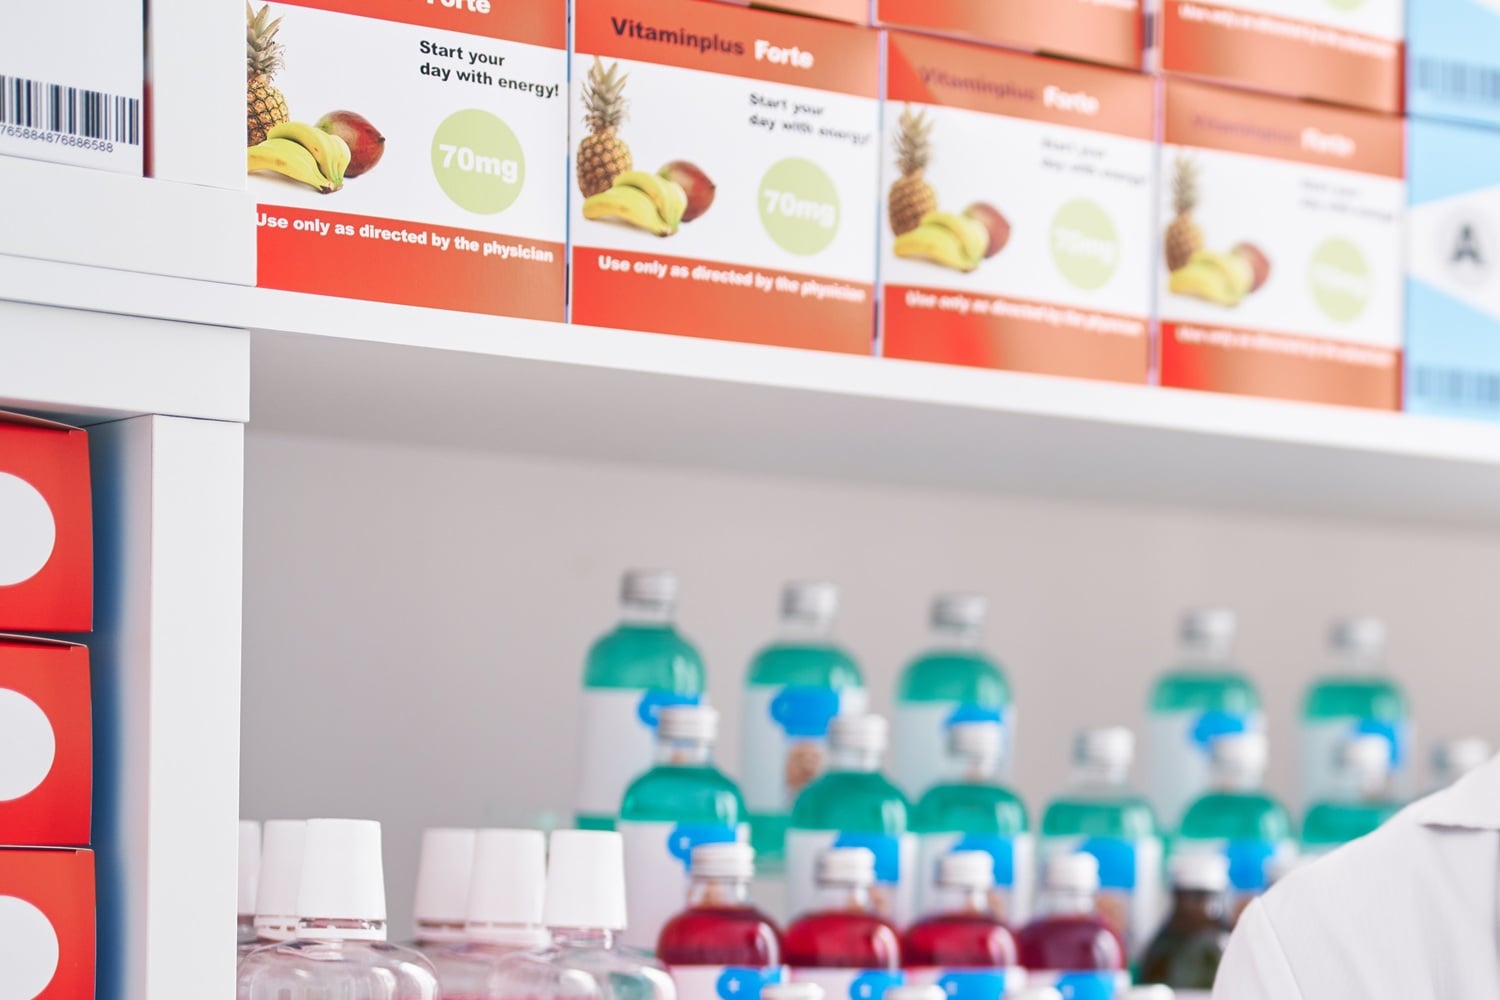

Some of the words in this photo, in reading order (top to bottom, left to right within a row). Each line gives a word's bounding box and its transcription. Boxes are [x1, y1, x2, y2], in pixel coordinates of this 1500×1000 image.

[420, 40, 463, 60] Start
[469, 50, 505, 66] your
[611, 17, 745, 56] Vitaminplus
[754, 39, 815, 69] Forte
[420, 62, 451, 82] day
[456, 69, 493, 86] with
[498, 77, 559, 99] energy!
[439, 143, 519, 184] 70mg
[763, 189, 837, 229] 70mg
[256, 212, 289, 229] Use
[293, 218, 330, 236] only
[334, 222, 355, 236] as
[359, 224, 428, 245] directed
[431, 232, 451, 251] by
[454, 236, 480, 252] the
[483, 241, 554, 263] physician
[598, 254, 631, 272] Use
[634, 260, 668, 279] only
[671, 264, 690, 280] as
[692, 265, 754, 287] directed
[755, 272, 774, 293] by
